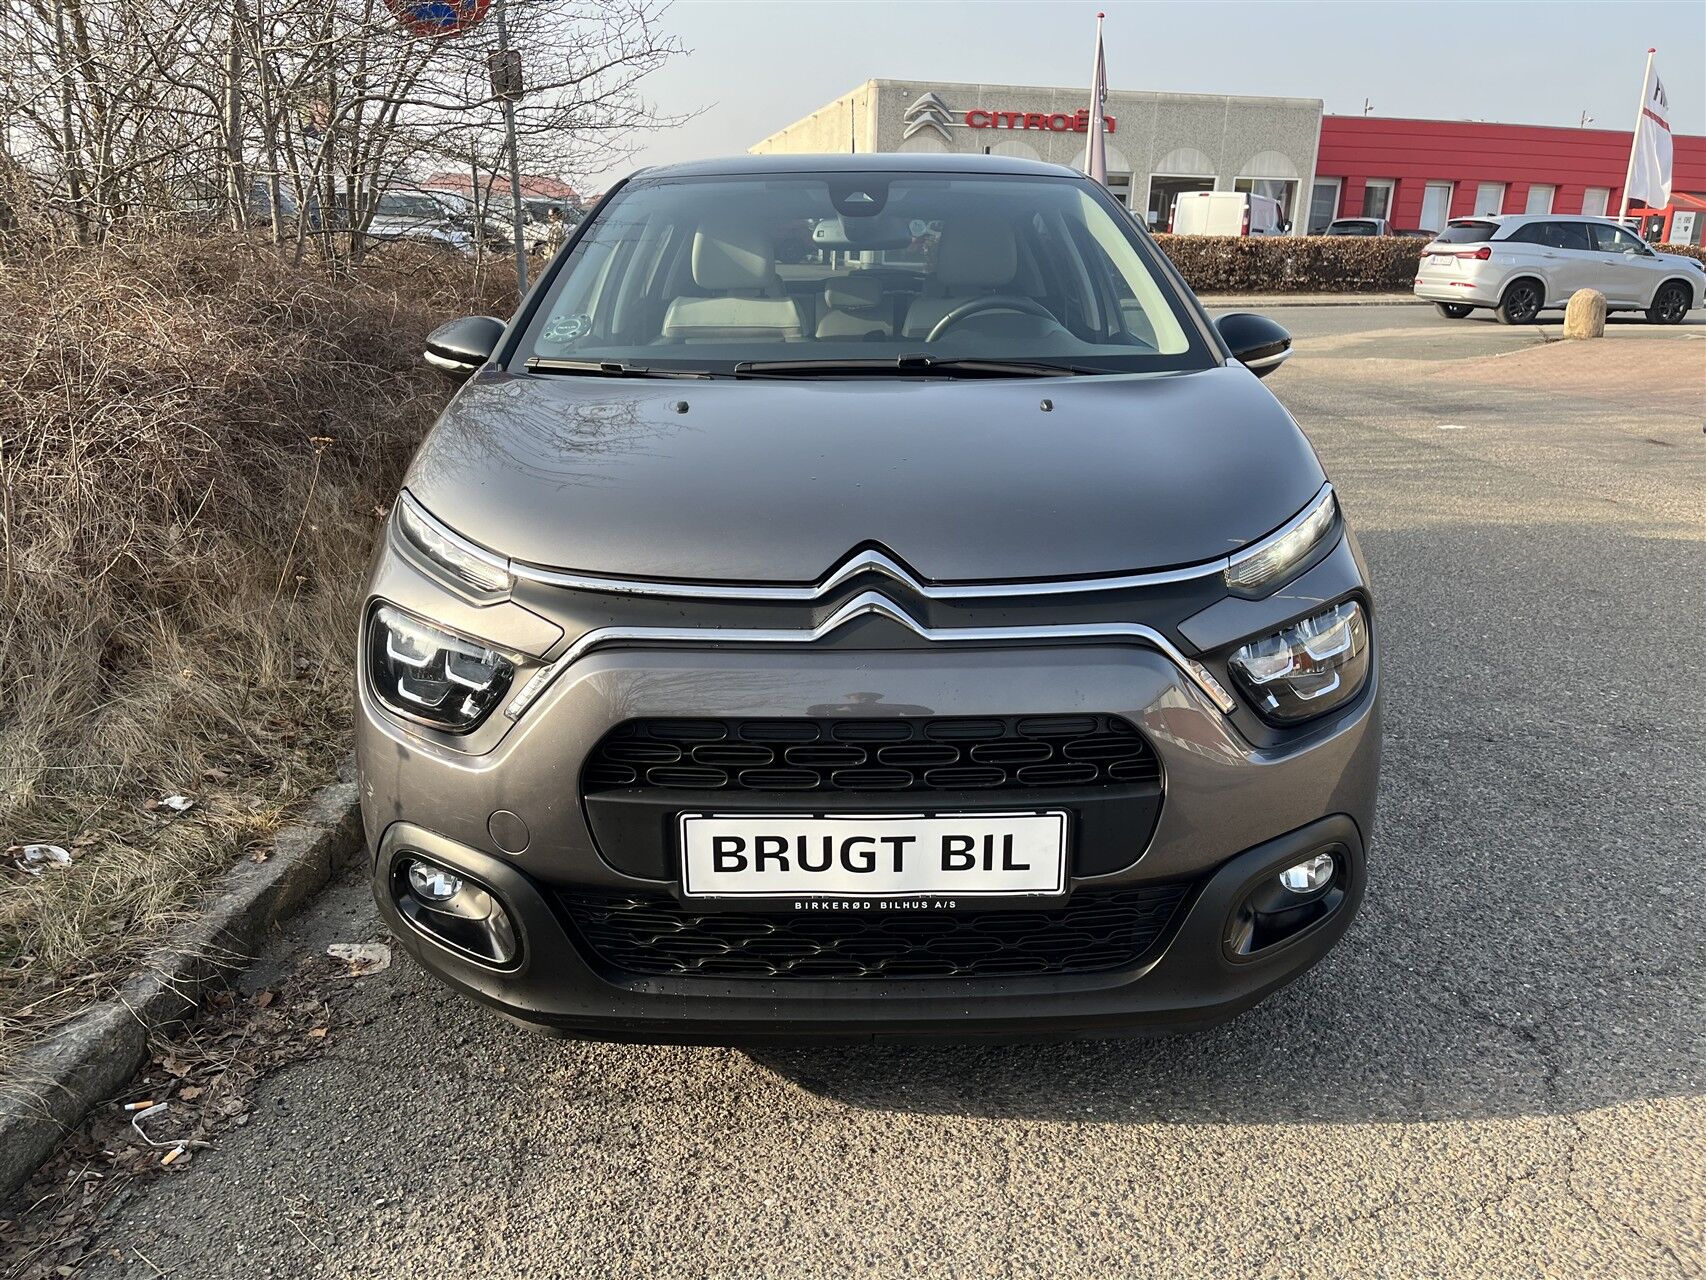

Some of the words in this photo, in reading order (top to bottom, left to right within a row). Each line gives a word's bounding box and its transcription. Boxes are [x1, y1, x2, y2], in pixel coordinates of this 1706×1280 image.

[712, 835, 916, 873] BRUGT
[941, 834, 1030, 872] BIL
[795, 901, 871, 910] BIRKERØD
[880, 901, 928, 910] BILHUS
[934, 901, 956, 909] A/S
